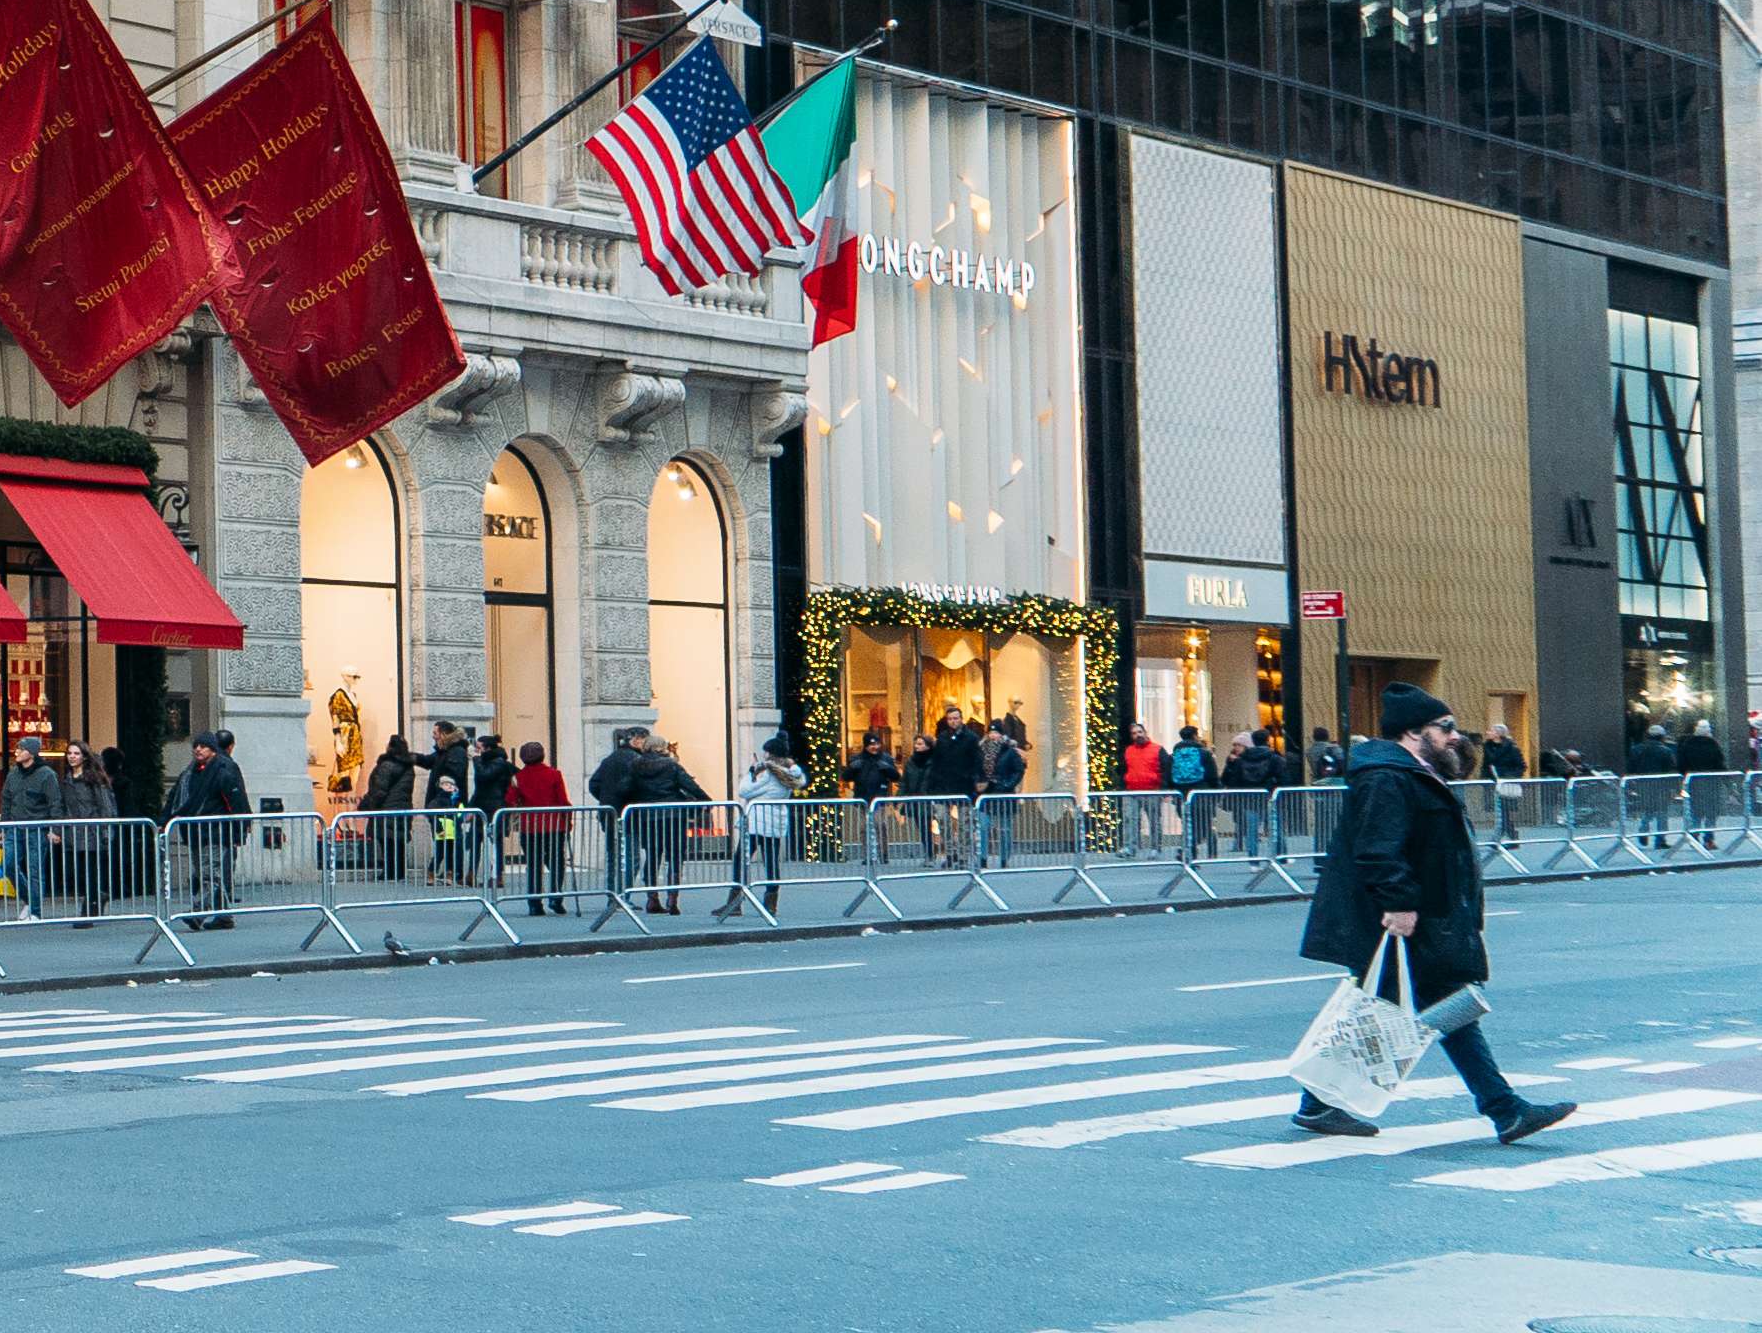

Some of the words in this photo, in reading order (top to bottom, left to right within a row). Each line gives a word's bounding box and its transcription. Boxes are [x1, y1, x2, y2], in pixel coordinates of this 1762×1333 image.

[700, 16, 750, 39] VERSACE
[10, 138, 41, 176] God
[38, 110, 77, 150] Helg
[203, 153, 260, 199] Happy
[261, 102, 329, 161] Holidays
[246, 220, 294, 257] Frohe
[293, 169, 359, 227] Feiertage
[860, 233, 1035, 299] ONGCHAMP
[74, 273, 122, 314] Sretni
[325, 342, 378, 379] Bones
[1187, 574, 1249, 608] FURLA
[151, 623, 193, 644] Cartier
